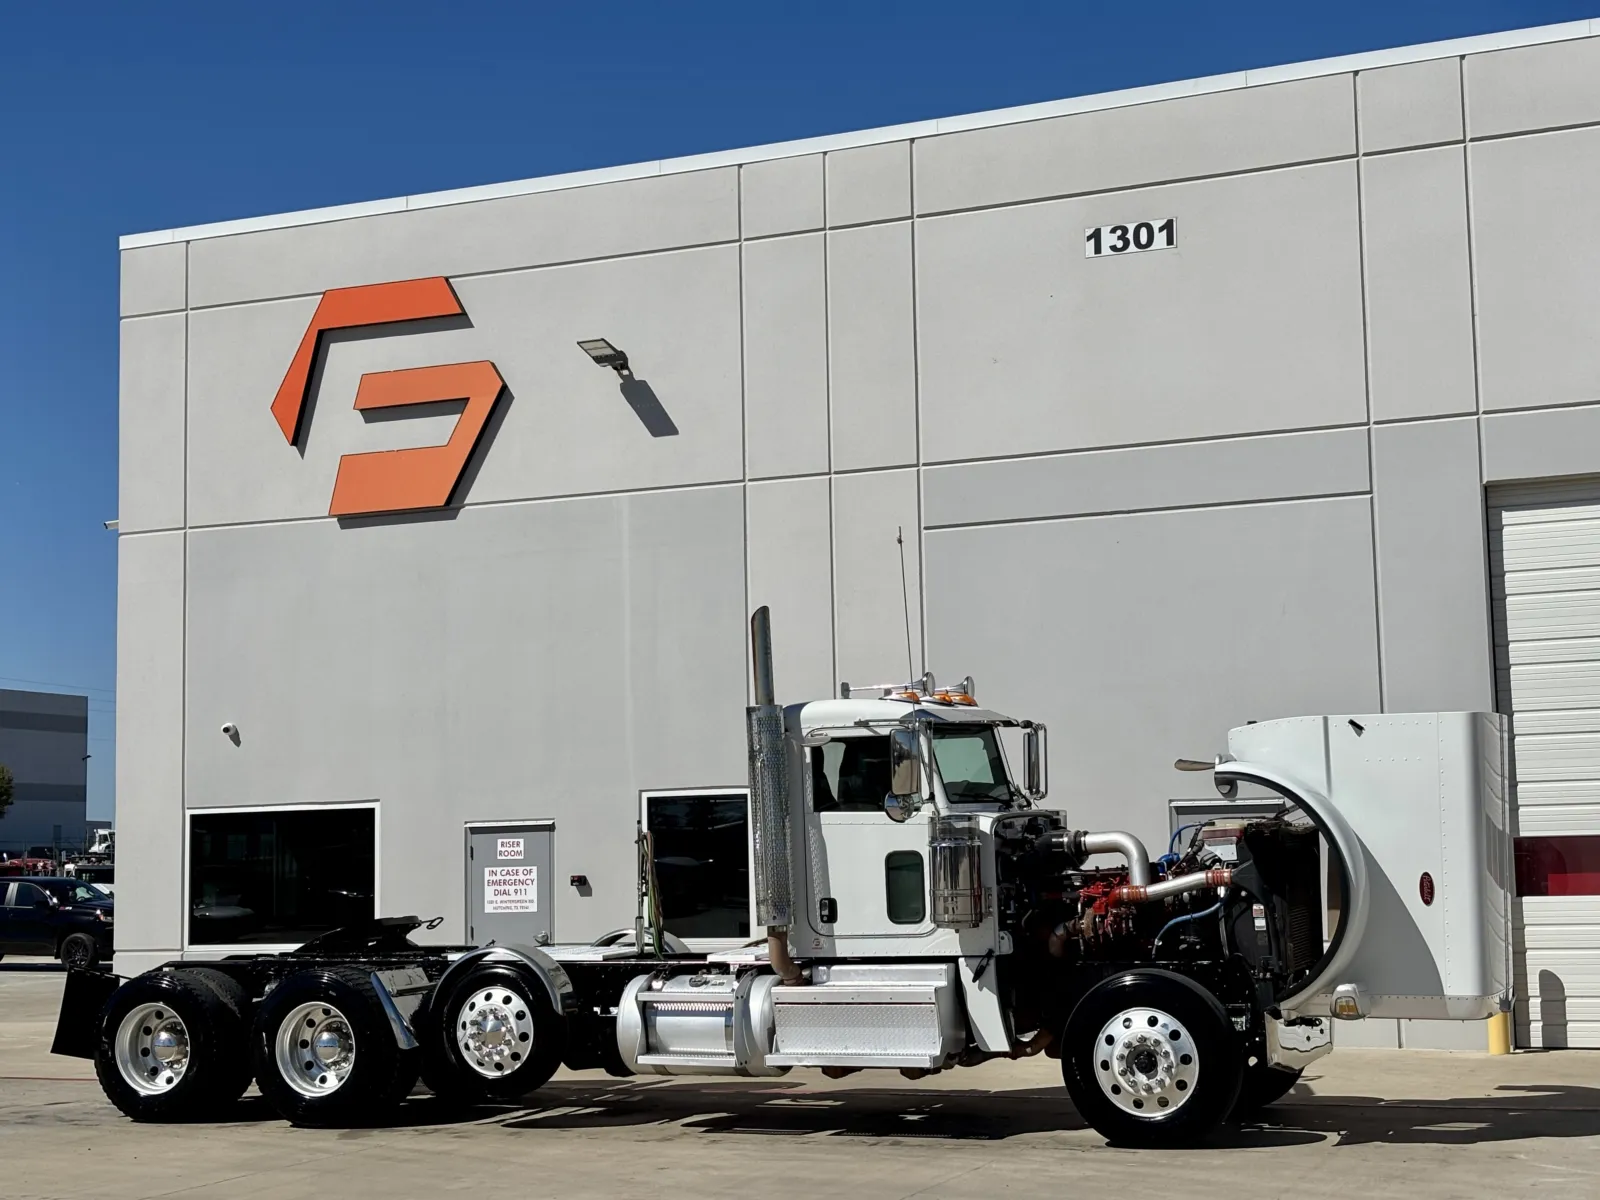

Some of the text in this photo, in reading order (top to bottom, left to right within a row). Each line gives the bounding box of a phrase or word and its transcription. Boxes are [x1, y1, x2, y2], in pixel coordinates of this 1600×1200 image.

[1086, 218, 1175, 255] 1301
[500, 840, 521, 848] RISER
[498, 849, 523, 857] ROOM
[488, 868, 534, 877] IN CASE OF
[487, 878, 535, 887] EMERGENCY
[493, 888, 528, 897] DIAL 911
